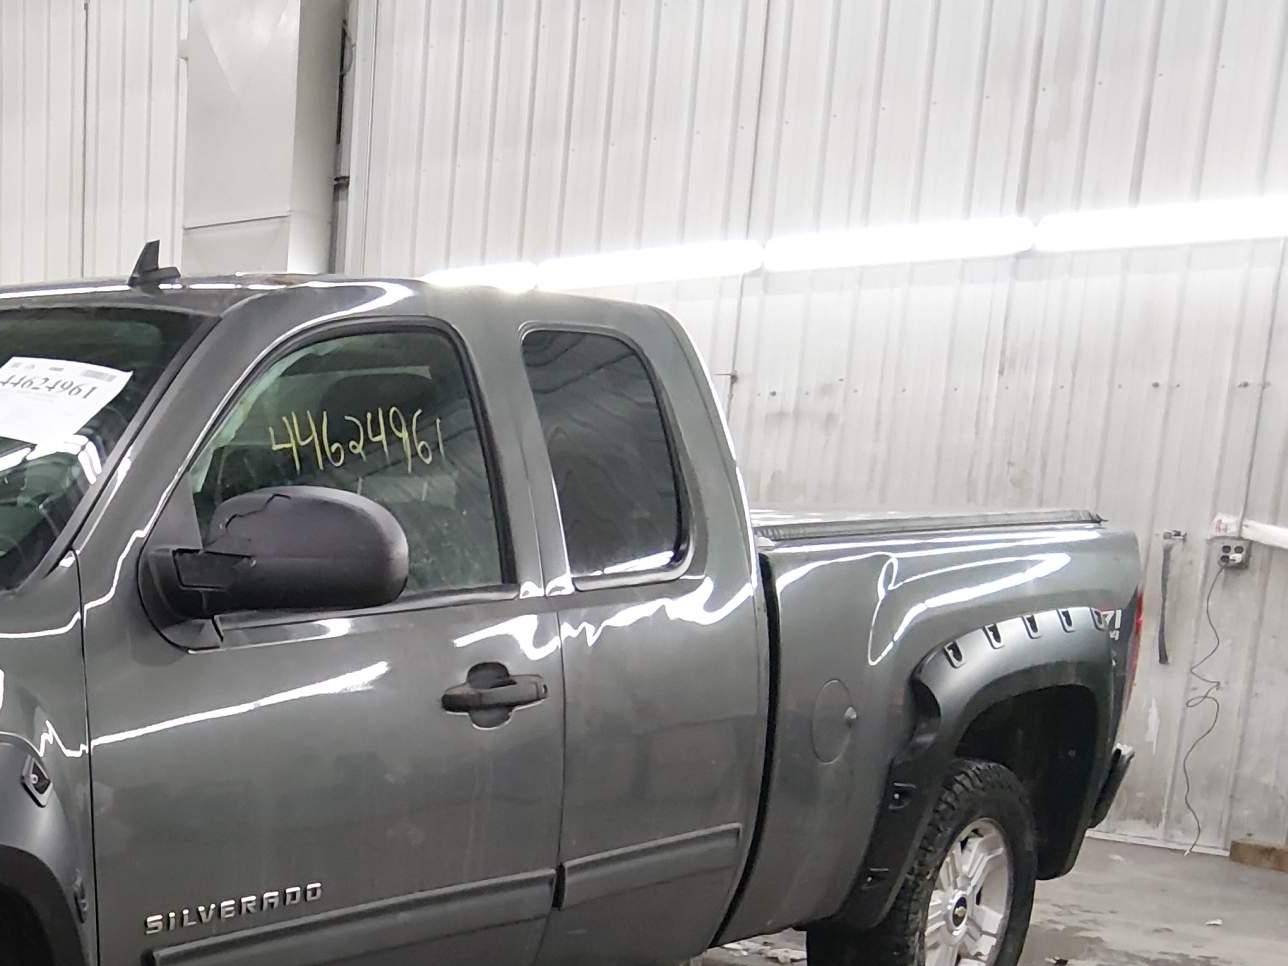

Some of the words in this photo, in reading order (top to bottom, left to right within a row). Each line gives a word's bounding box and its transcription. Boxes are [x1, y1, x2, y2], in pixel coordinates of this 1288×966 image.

[0, 374, 99, 399] 44624961
[268, 406, 446, 475] 44624961
[145, 882, 322, 935] SILVERADO
